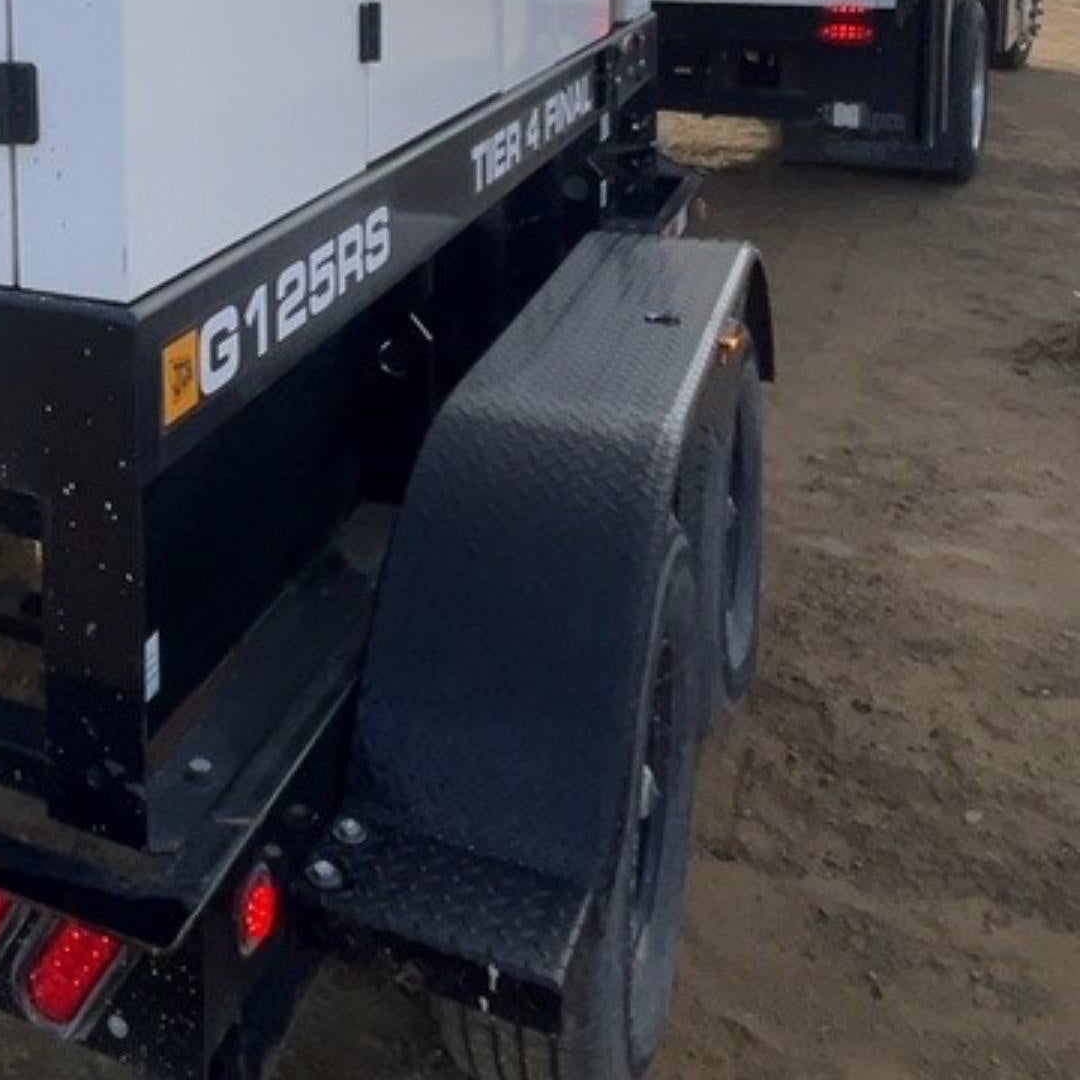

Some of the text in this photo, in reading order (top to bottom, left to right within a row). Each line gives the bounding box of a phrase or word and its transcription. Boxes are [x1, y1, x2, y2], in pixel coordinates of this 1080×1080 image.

[470, 119, 521, 193] TIER
[525, 106, 540, 151] 4
[199, 205, 391, 397] G125RS
